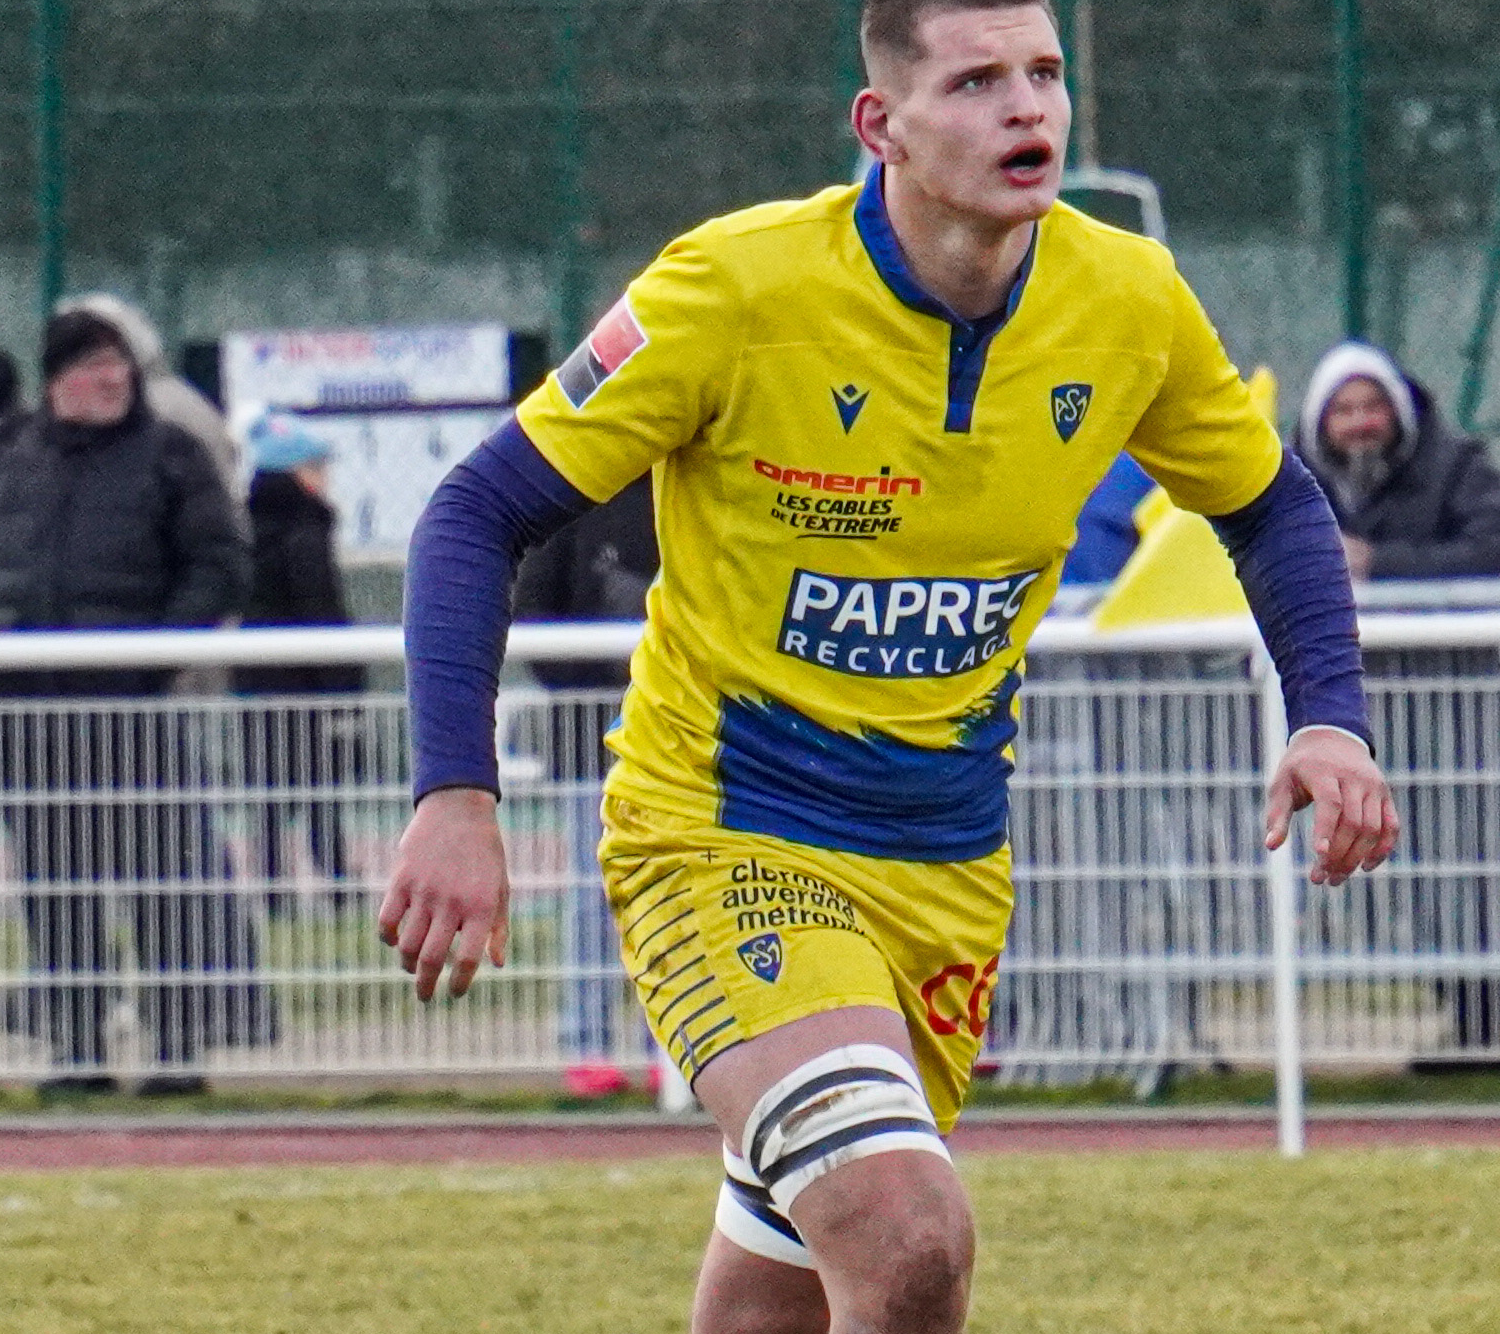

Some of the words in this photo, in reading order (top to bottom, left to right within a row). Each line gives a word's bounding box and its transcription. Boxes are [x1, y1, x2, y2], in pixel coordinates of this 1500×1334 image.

[754, 458, 923, 496] amerin
[776, 491, 813, 512] LES
[814, 498, 894, 516] CABLES
[789, 512, 903, 534] L'EXTREME
[790, 571, 1040, 637] PAPREC
